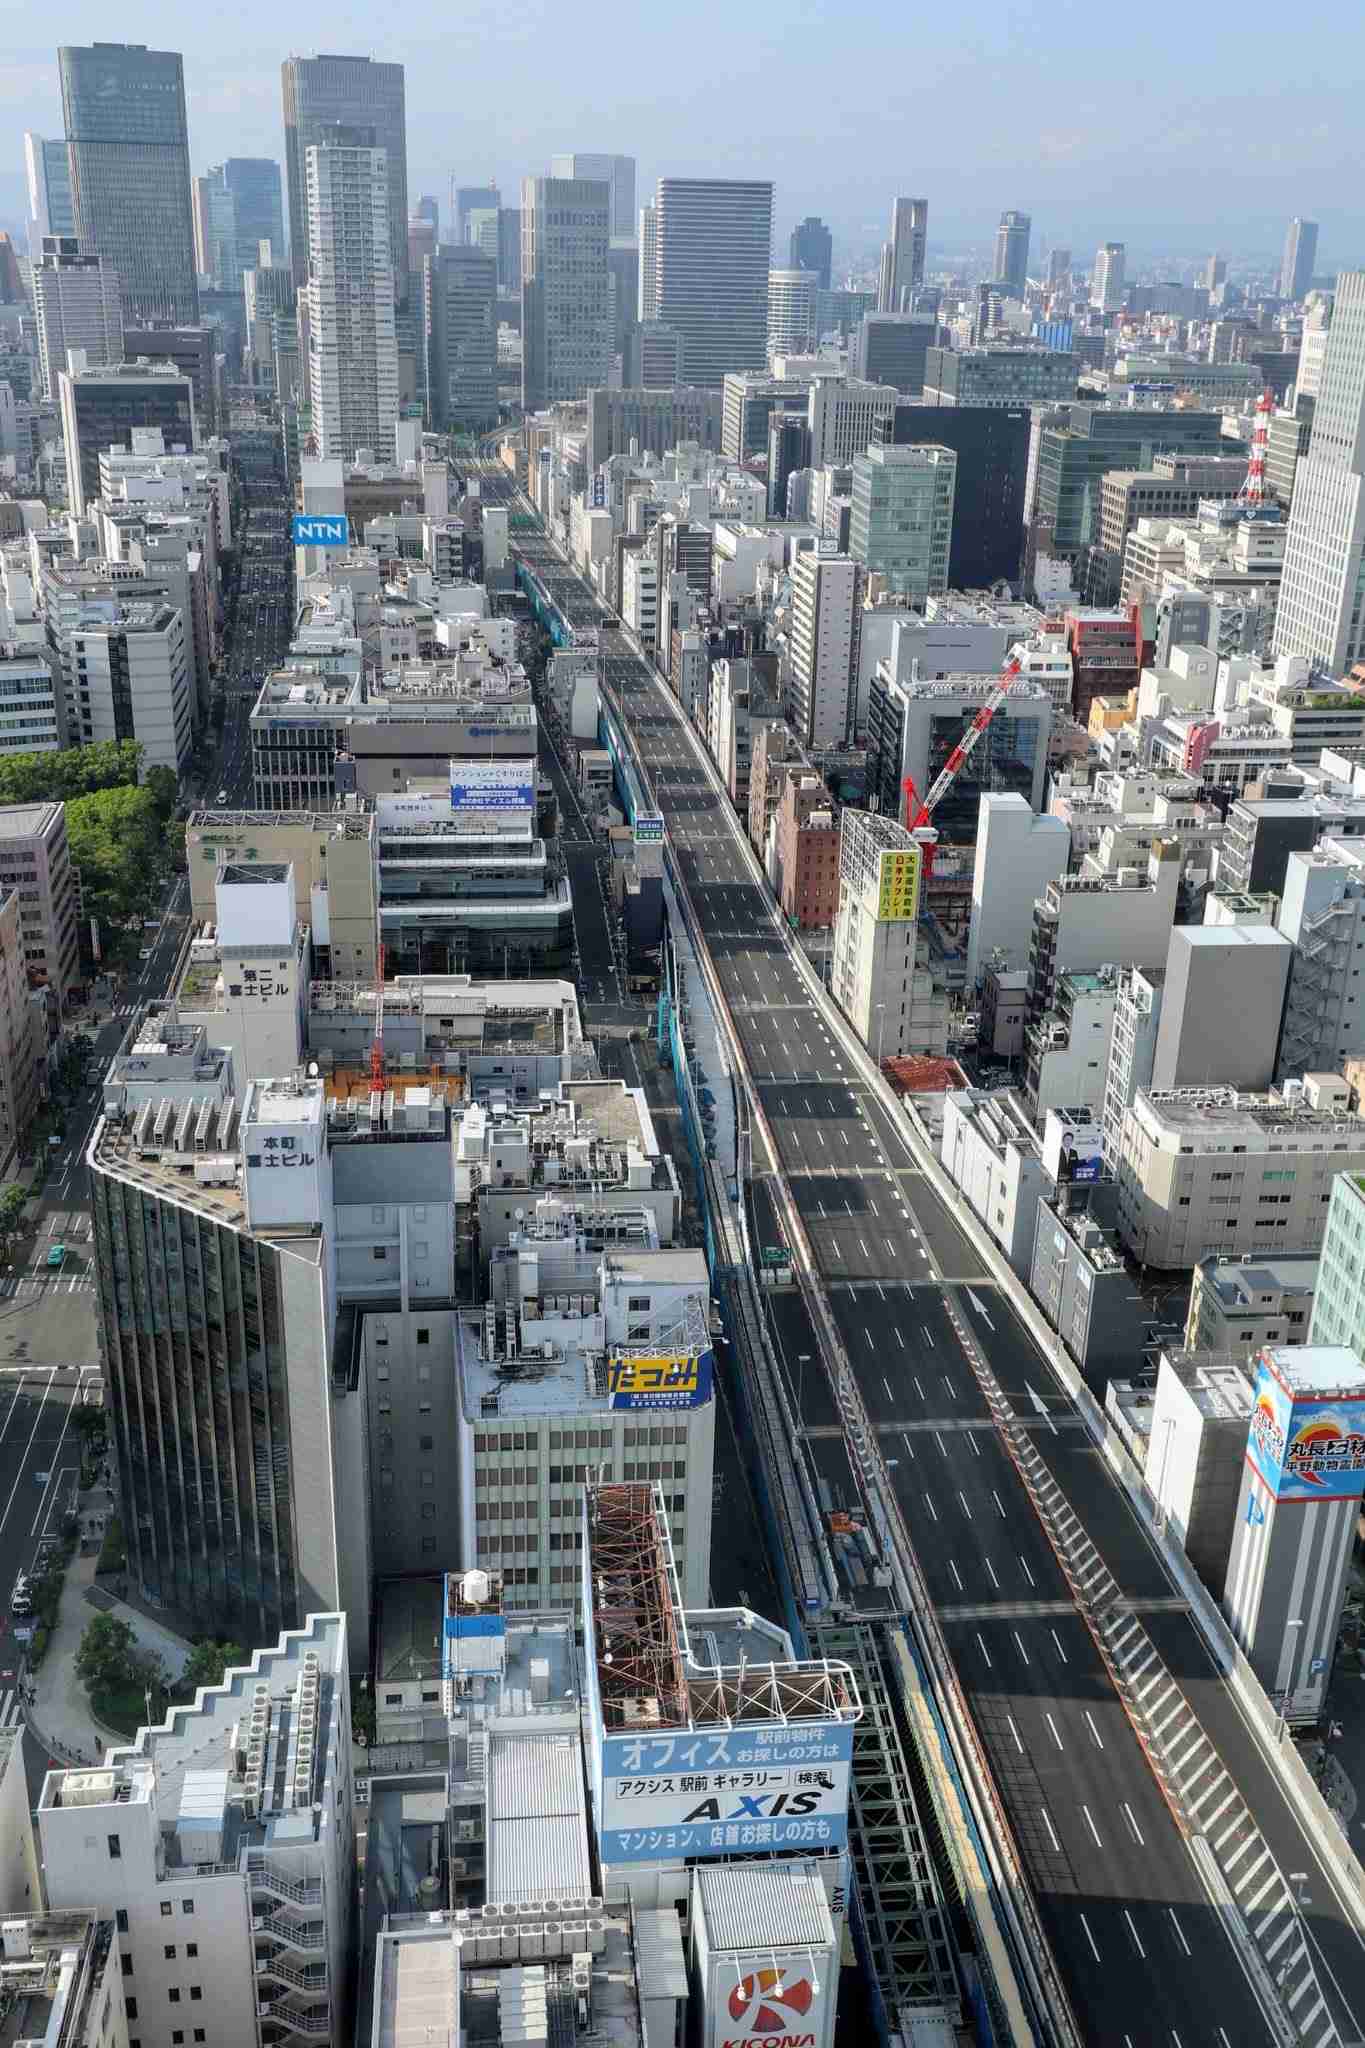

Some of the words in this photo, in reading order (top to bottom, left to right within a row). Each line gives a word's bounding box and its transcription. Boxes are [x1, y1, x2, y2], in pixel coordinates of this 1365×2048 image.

[298, 523, 341, 538] NTN
[244, 969, 272, 982] 第二
[229, 984, 289, 996] 富士ビル
[264, 1136, 295, 1149] 本町
[247, 1153, 314, 1167] 富士ビル
[755, 1728, 825, 1744] 駅前物件
[621, 1736, 731, 1770] オフィス
[737, 1744, 839, 1762] お探しの方は
[619, 1777, 674, 1796] アクシス
[680, 1776, 708, 1792] 駅前
[714, 1772, 783, 1789] ギャラリー
[798, 1770, 831, 1785] 検索
[681, 1791, 822, 1822] AXIS
[832, 1886, 845, 1913] AXIS
